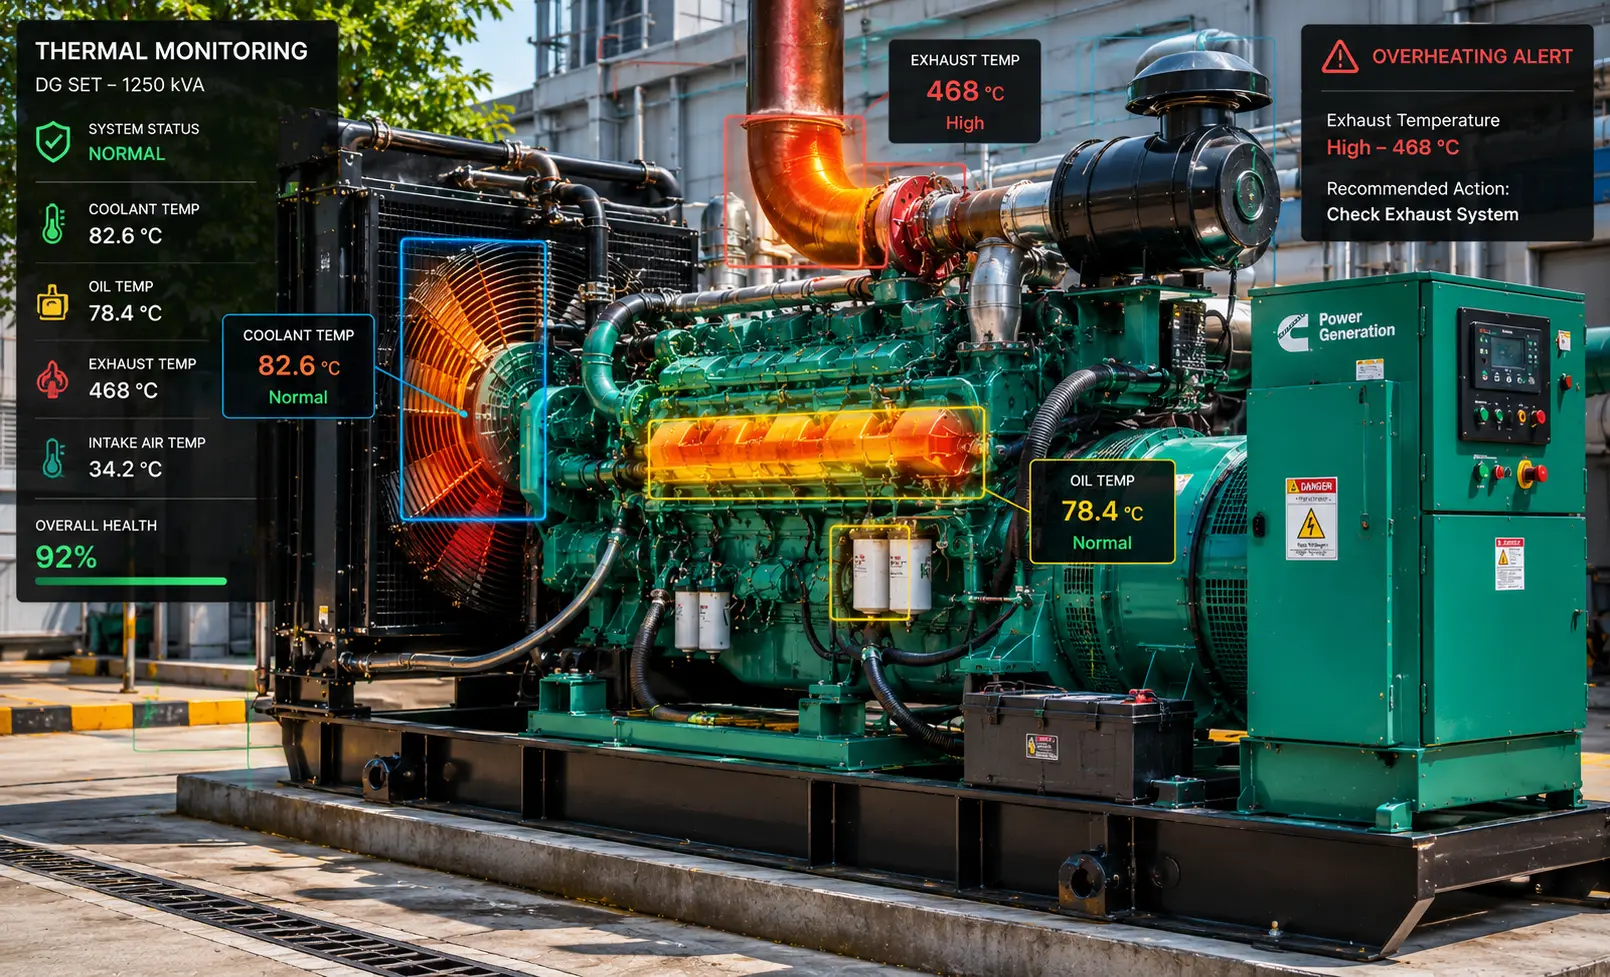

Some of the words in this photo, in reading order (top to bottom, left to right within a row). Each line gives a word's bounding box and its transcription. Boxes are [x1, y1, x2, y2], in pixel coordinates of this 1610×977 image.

[1319, 312, 1363, 326] Power
[1319, 324, 1396, 342] Generation
[1301, 482, 1333, 491] DANGER
